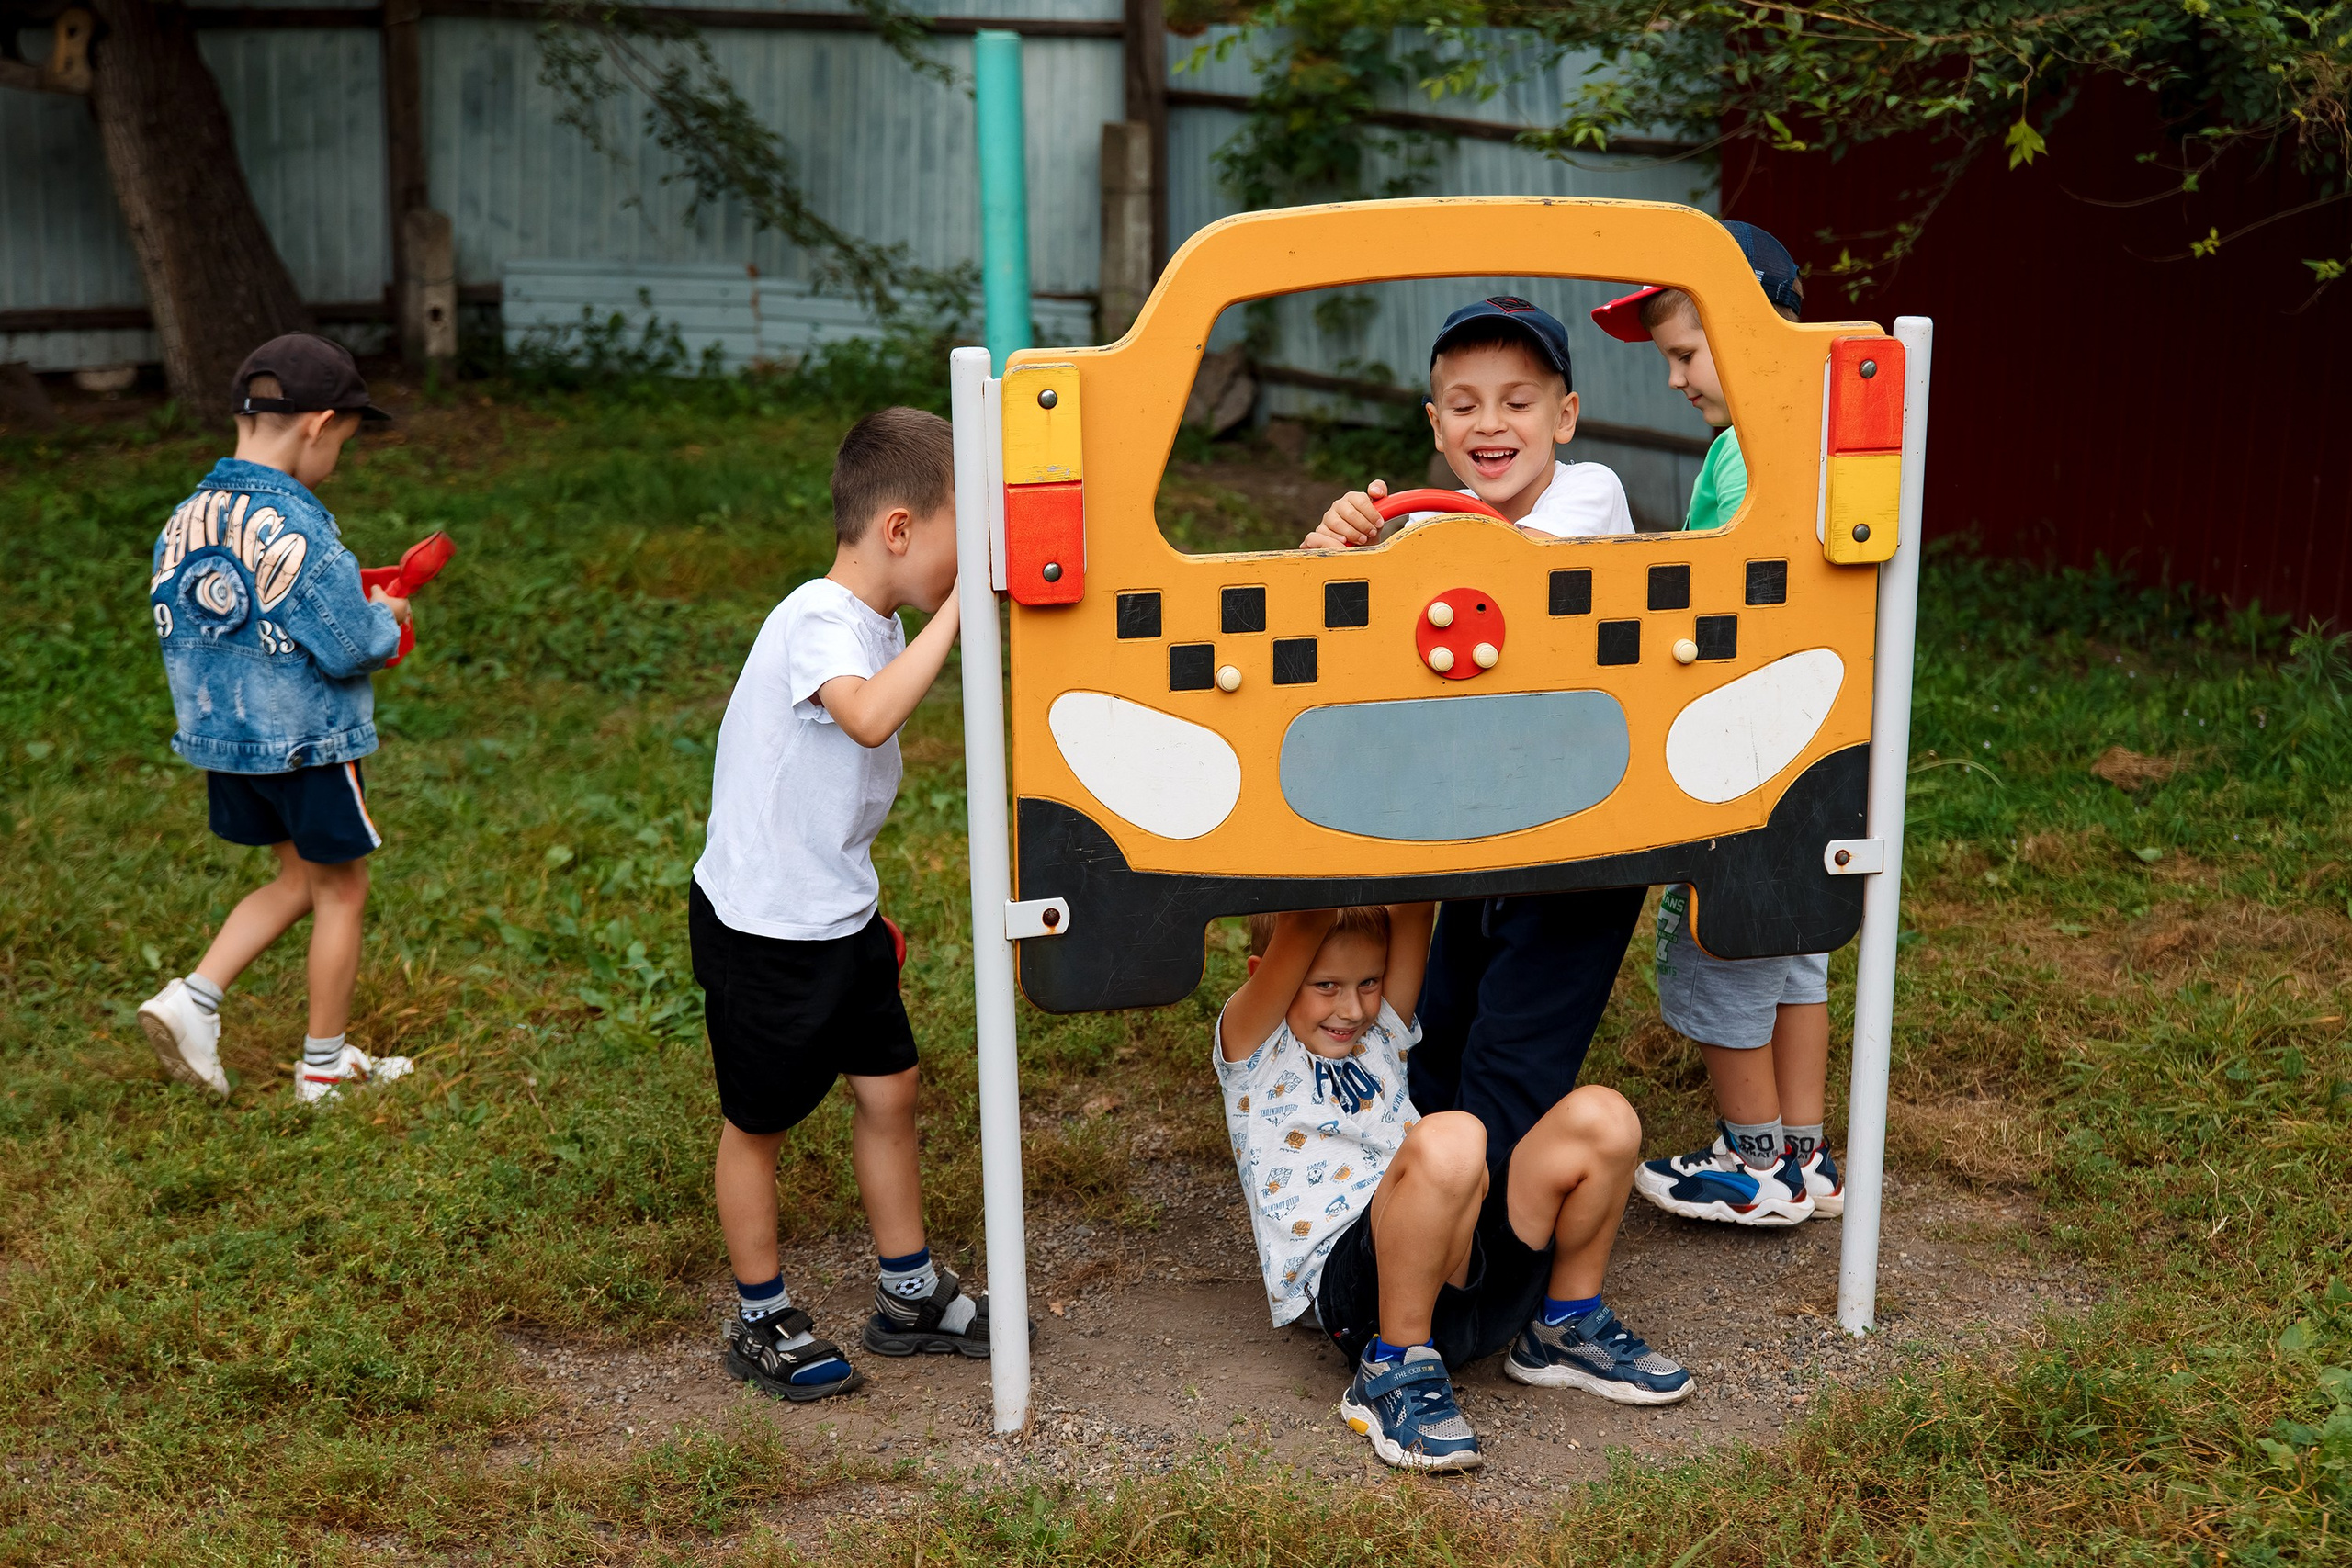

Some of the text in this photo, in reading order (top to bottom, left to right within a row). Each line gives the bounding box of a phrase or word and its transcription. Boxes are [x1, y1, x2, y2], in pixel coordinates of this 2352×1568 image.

[150, 489, 308, 614] HICAGO
[1664, 896, 1685, 913] ANS
[1738, 1134, 1775, 1152] SO
